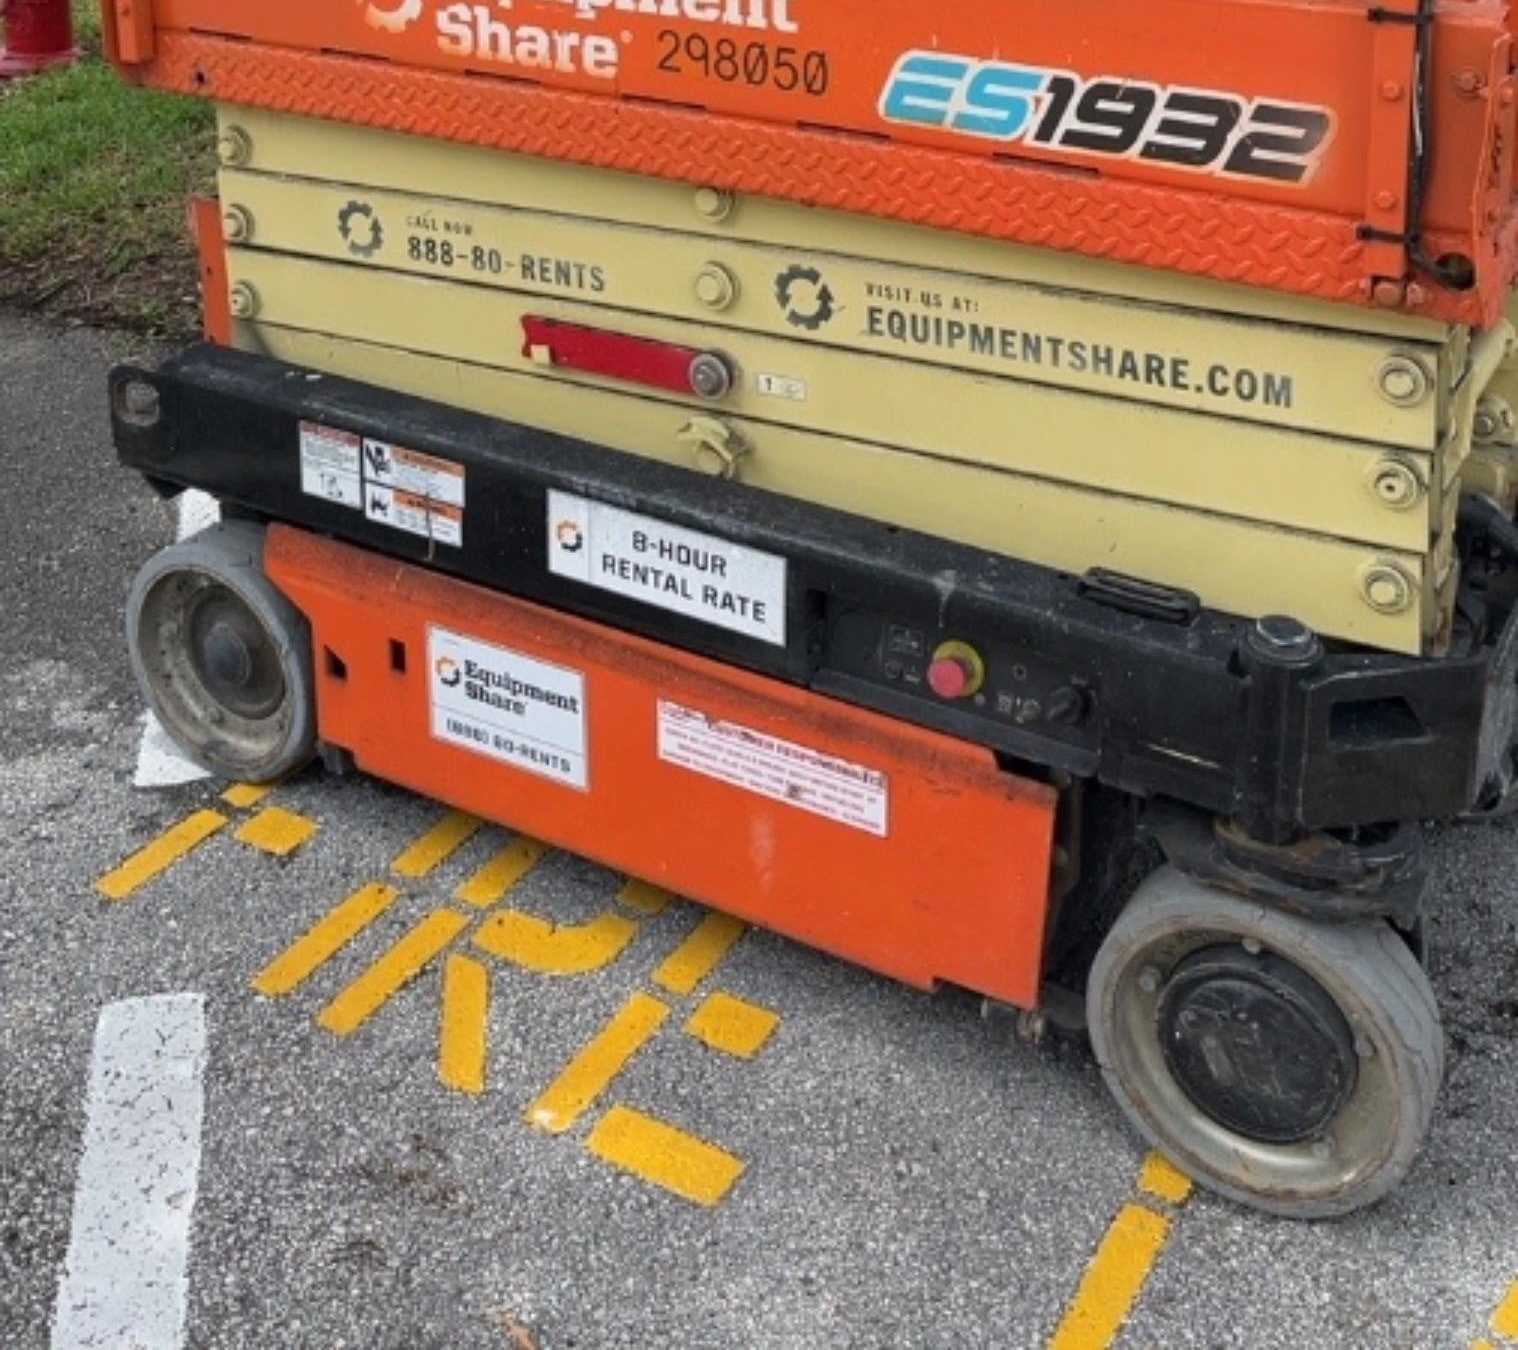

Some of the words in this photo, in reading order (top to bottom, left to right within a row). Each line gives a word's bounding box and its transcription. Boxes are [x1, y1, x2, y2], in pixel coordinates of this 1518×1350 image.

[436, 3, 620, 80] Share
[656, 30, 830, 96] 298050
[881, 52, 1334, 184] ES1932
[406, 214, 438, 232] CALL
[443, 221, 473, 236] NOW
[407, 235, 605, 293] 888-80-RENTS
[865, 282, 911, 304] VISIT
[920, 290, 943, 309] US
[951, 296, 979, 313] AT:
[866, 305, 1293, 409] EQUIPMENTSHARE.COM
[602, 553, 694, 601] RENTAL
[702, 584, 767, 623] RATE
[464, 659, 580, 715] Equipment
[464, 680, 526, 716] Share
